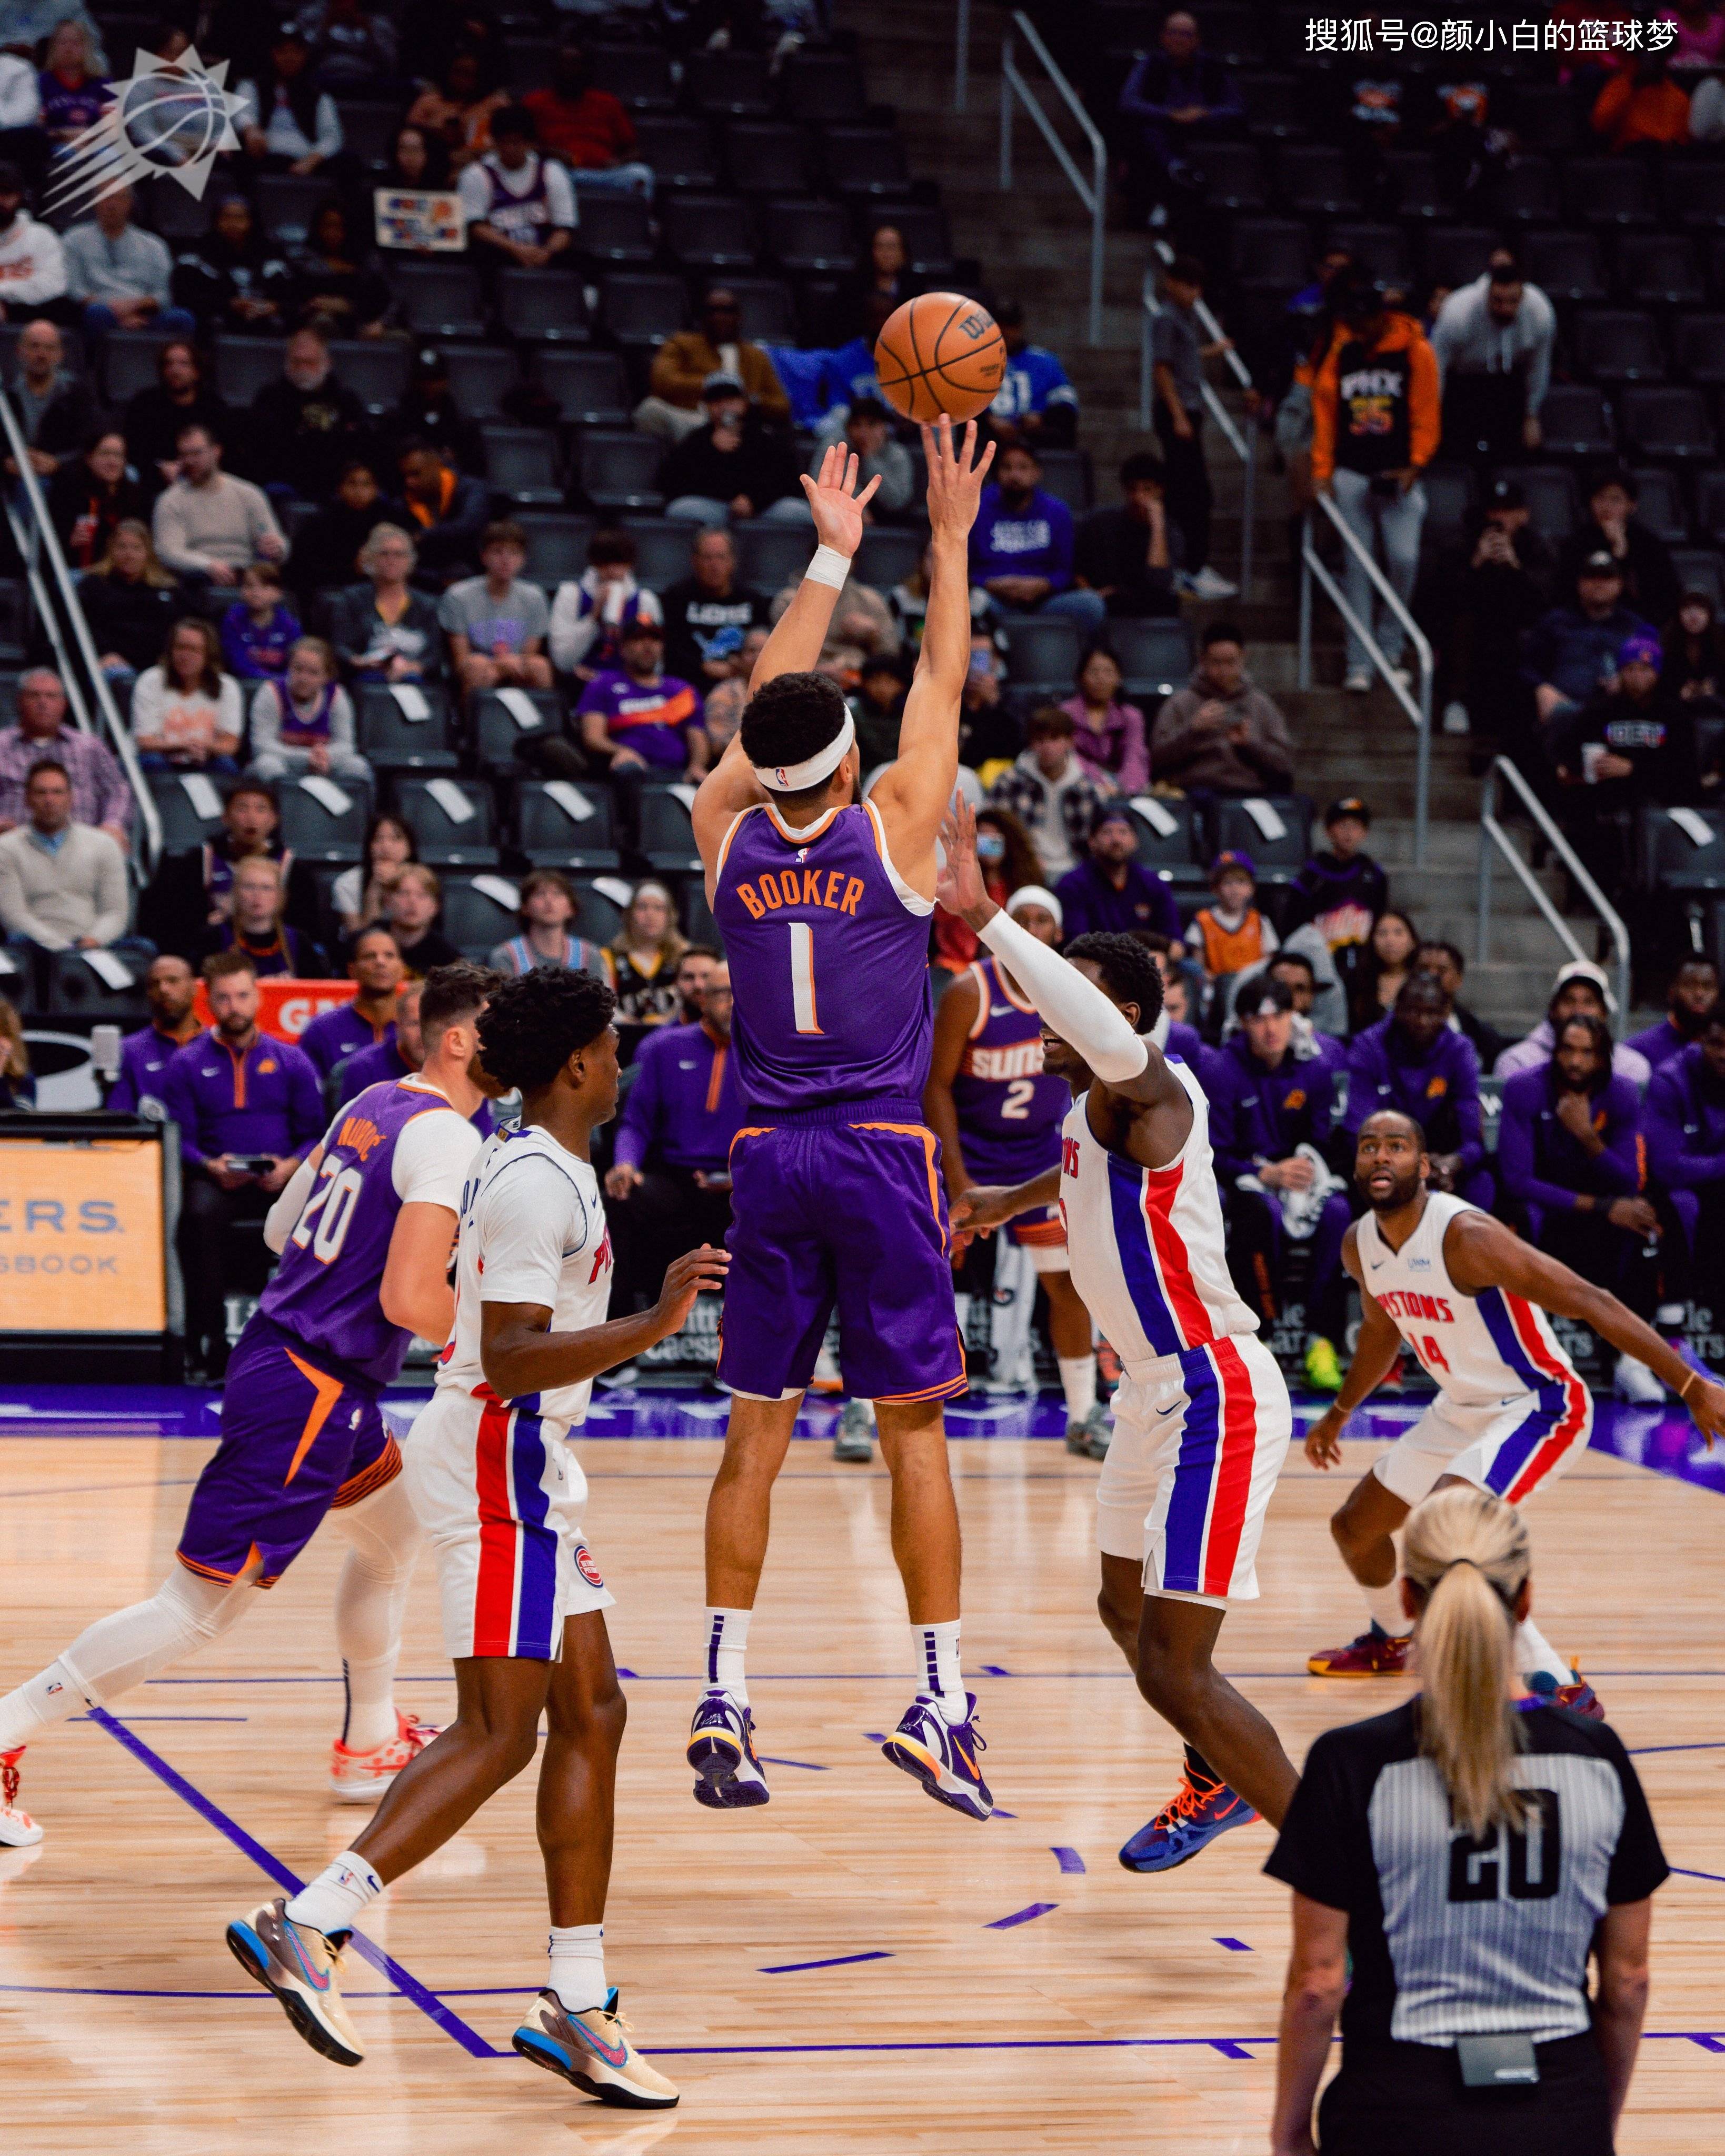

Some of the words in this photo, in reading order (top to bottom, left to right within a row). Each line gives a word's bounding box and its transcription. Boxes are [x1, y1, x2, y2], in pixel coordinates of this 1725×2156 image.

[736, 870, 865, 920] BOOKER
[787, 922, 825, 1034] 1
[1001, 1080, 1035, 1120] 2
[292, 1154, 362, 1265] 20
[1408, 1332, 1451, 1374] 14
